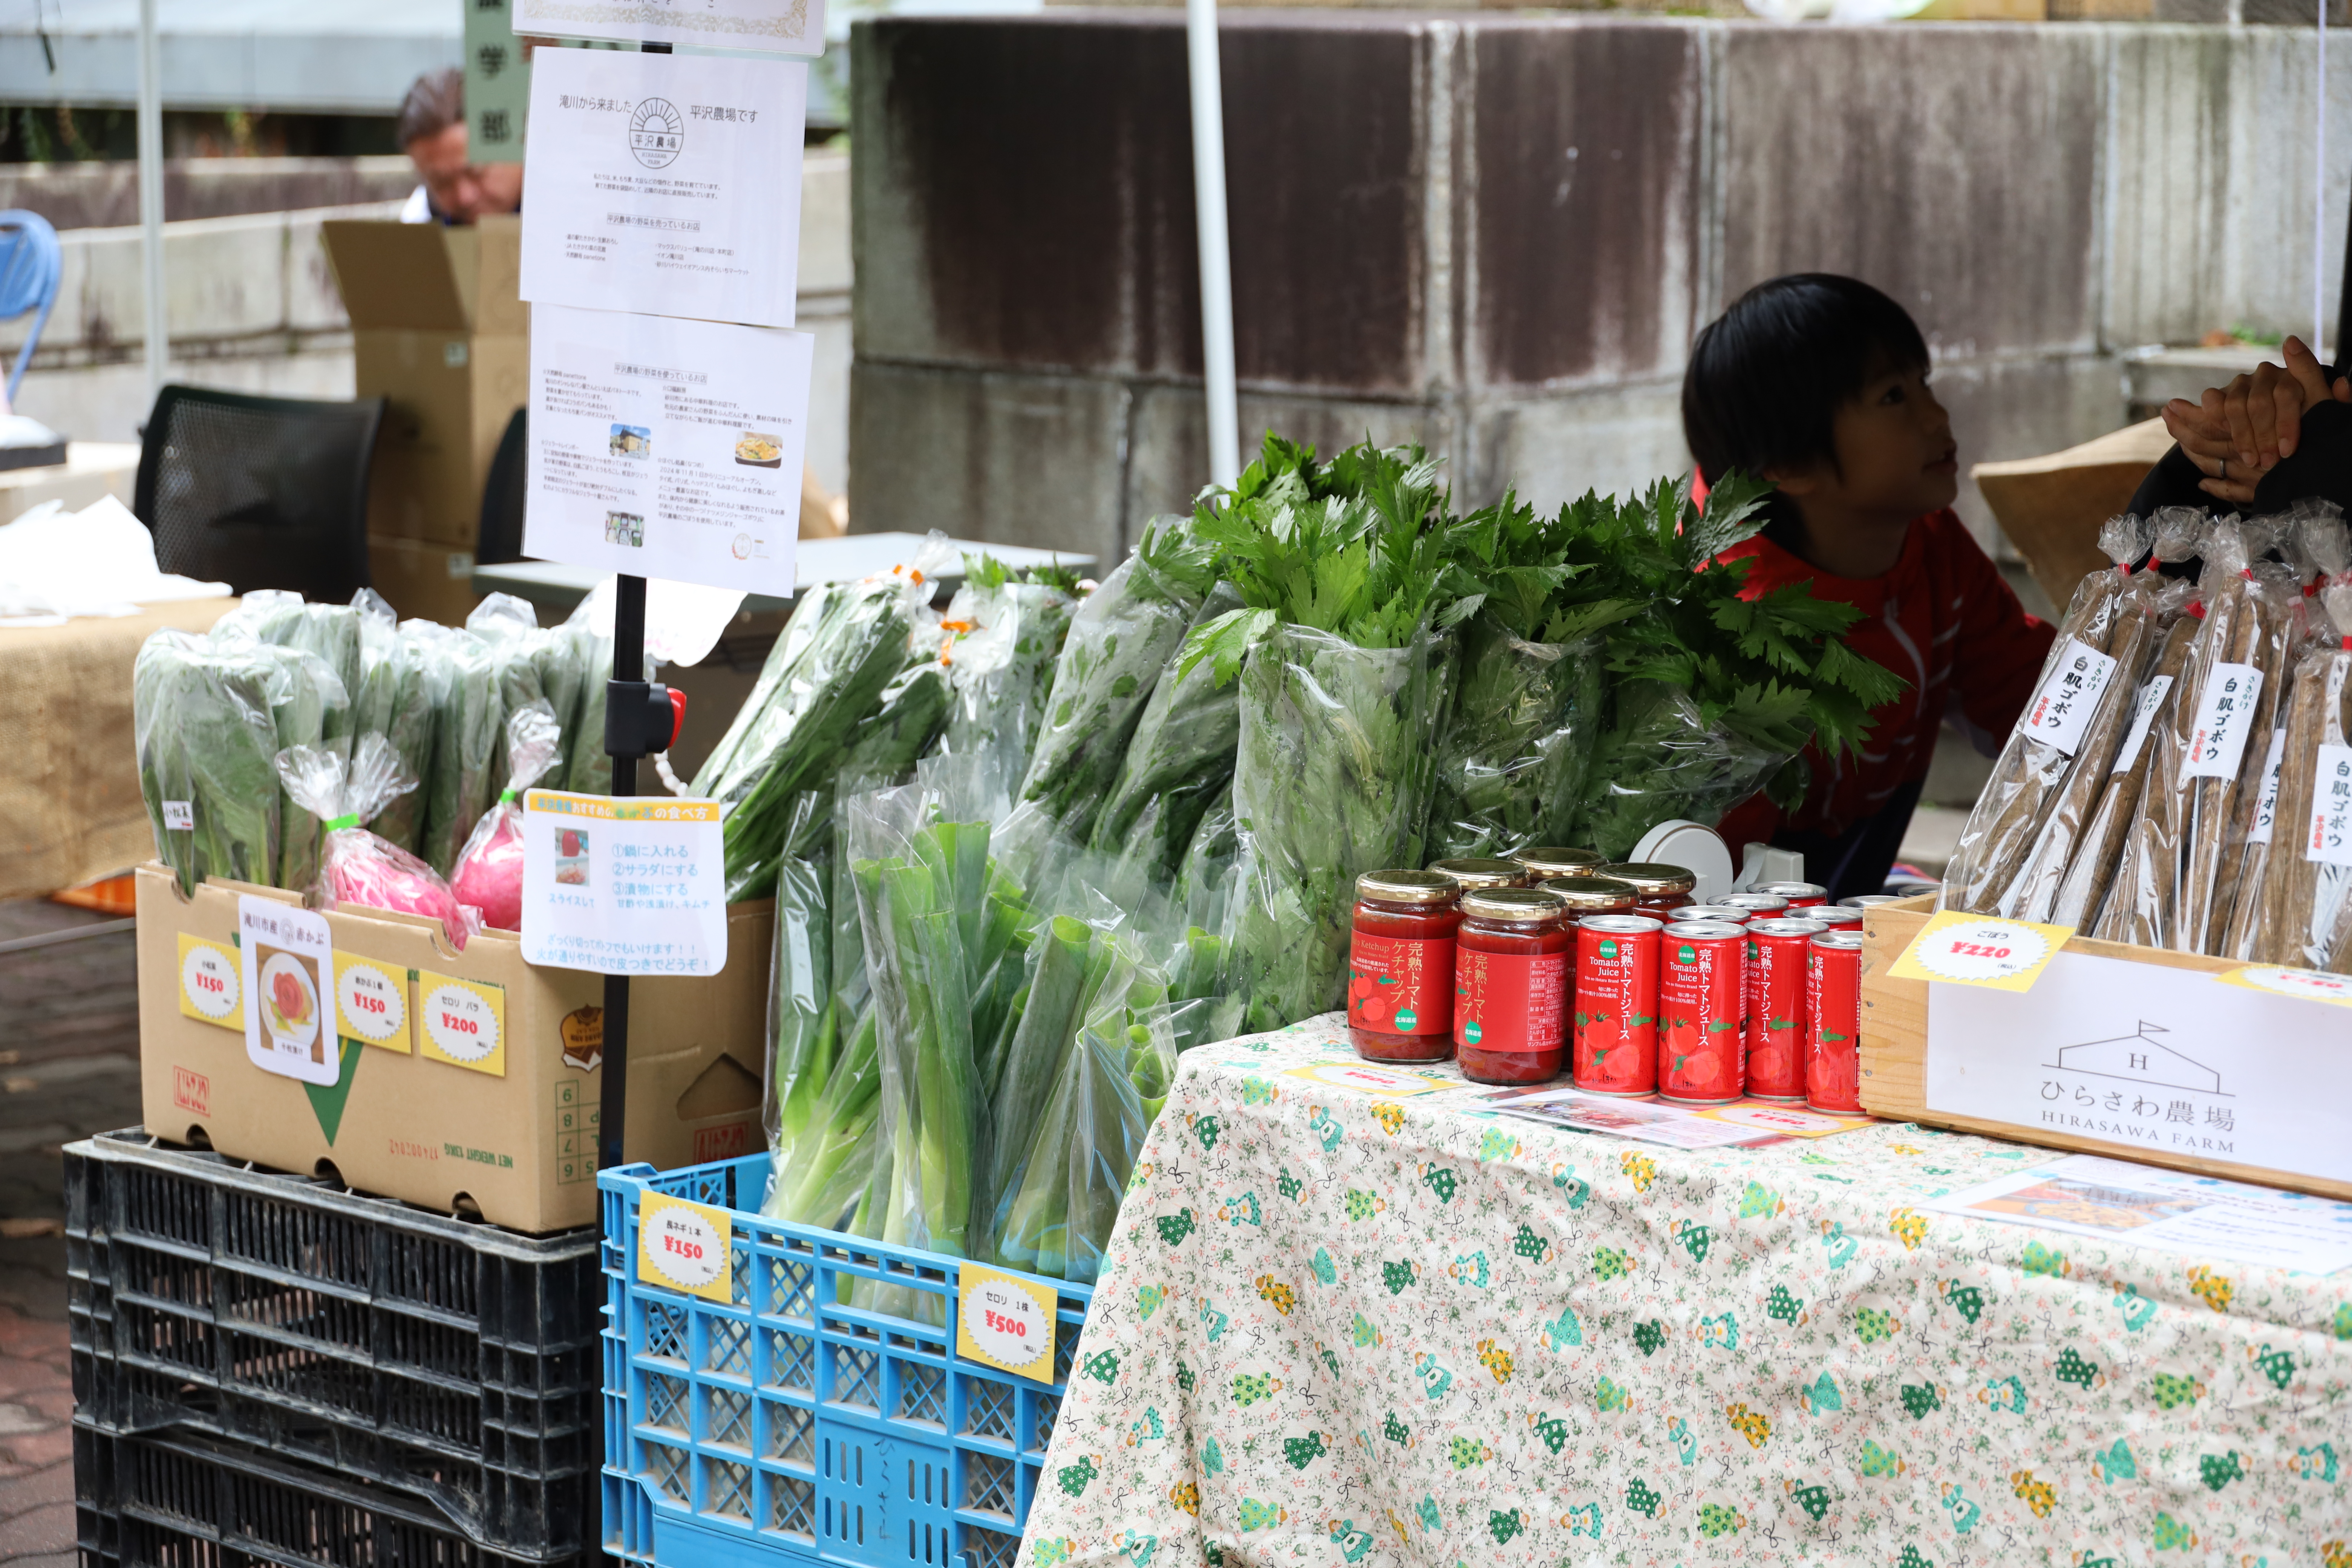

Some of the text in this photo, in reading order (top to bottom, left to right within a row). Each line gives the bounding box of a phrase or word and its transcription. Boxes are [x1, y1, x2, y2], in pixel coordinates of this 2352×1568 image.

[559, 94, 758, 123] 滝川から来ました 平沢農場です
[635, 134, 676, 149] 平沢農場
[607, 214, 700, 231] 平沢農場の野菜を売っているお店
[615, 364, 707, 383] 平沢農場の野菜を使っているお店
[2087, 658, 2106, 691] さきがけ
[2047, 656, 2089, 727] 白肌ゴボウ
[2144, 681, 2162, 712] さきがけ
[2239, 676, 2255, 710] さきがけ
[2207, 677, 2237, 760] 白肌ゴボウ
[2328, 760, 2350, 847] 白肌ゴボウ
[549, 893, 594, 908] スライスして
[244, 912, 324, 945] 滝川市産 赤かぶ
[1977, 931, 2009, 939] ごぼう
[1361, 939, 1390, 953] Ketchup
[1949, 941, 2011, 959] ¥220
[1390, 941, 1406, 1003] ケチャップ
[1589, 956, 1620, 967] Tomato
[1598, 967, 1619, 976] Juice
[1669, 962, 1698, 972] Tomato
[196, 972, 224, 993] ¥150
[1407, 942, 1424, 1010] 完熟トマト
[1462, 951, 1473, 1014] ケチャップ
[1677, 972, 1698, 982] Juice
[1474, 954, 1488, 1023] 完熟トマト
[1619, 943, 1634, 1040] 完熟トマトジュース
[1697, 948, 1712, 1046] 完熟トマトジュース
[1760, 945, 1772, 1043] 完熟トマトジュース
[354, 992, 386, 1013] ¥150
[441, 995, 479, 1012] セロリ バラ
[1813, 956, 1824, 1054] 完熟トマトジュース
[441, 1012, 478, 1035] ¥200
[1465, 1028, 1482, 1037] 北海道産
[2128, 1052, 2148, 1070] H
[2041, 1081, 2236, 1132] ひらさわ農場
[2041, 1110, 2234, 1153] HIRASAWA FARM
[466, 1147, 496, 1165] WEIGHT
[499, 1153, 513, 1169] NET
[664, 1234, 703, 1259] ¥150
[985, 1291, 1029, 1312] セロリ 1株
[985, 1309, 1026, 1337] ¥500
